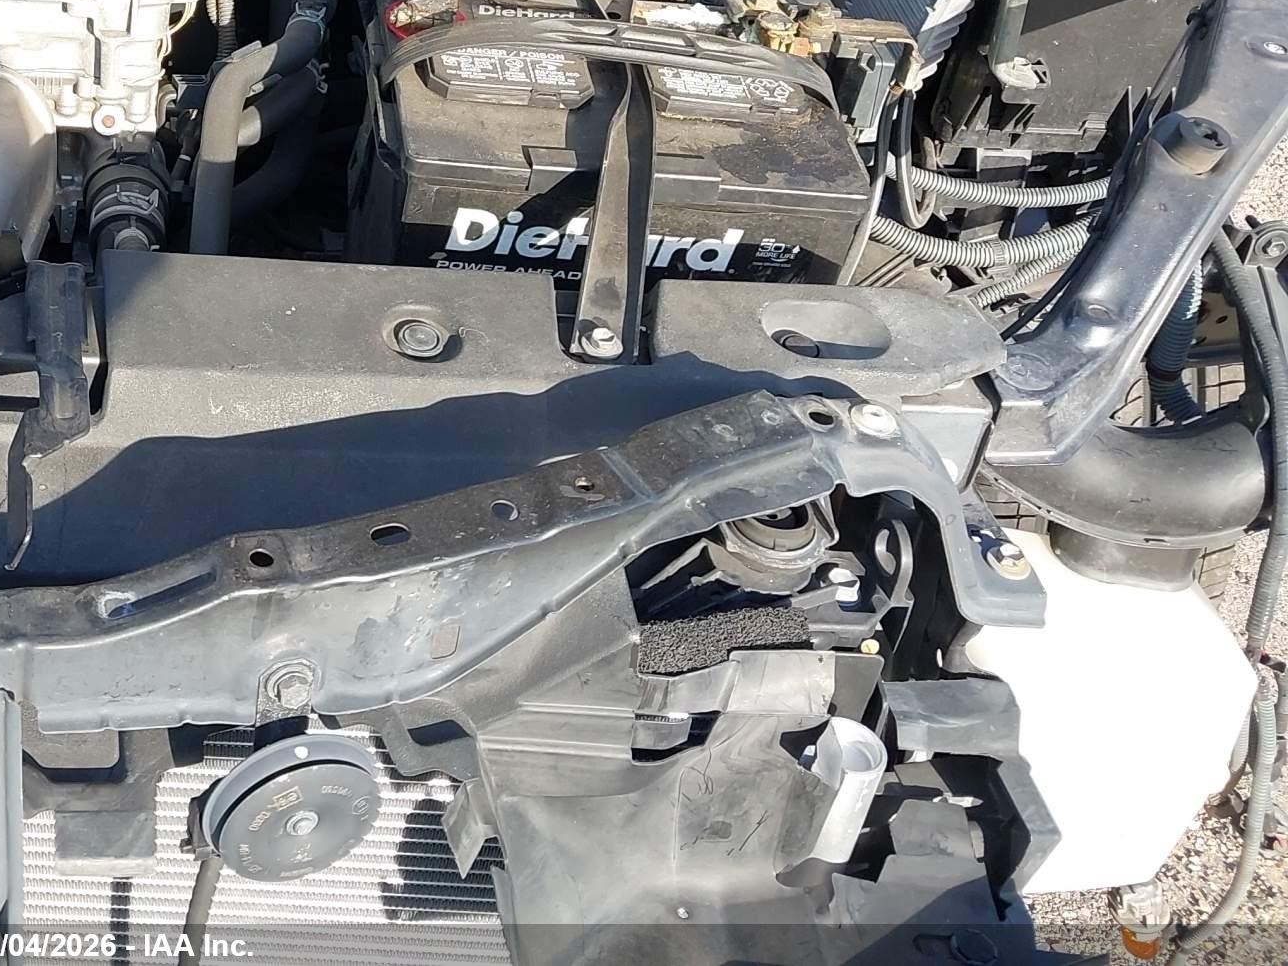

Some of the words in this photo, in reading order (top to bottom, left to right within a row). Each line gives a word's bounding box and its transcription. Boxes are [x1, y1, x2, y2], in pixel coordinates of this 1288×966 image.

[479, 4, 574, 19] DieHard
[519, 50, 565, 61] POISON
[445, 208, 744, 272] DieHrd
